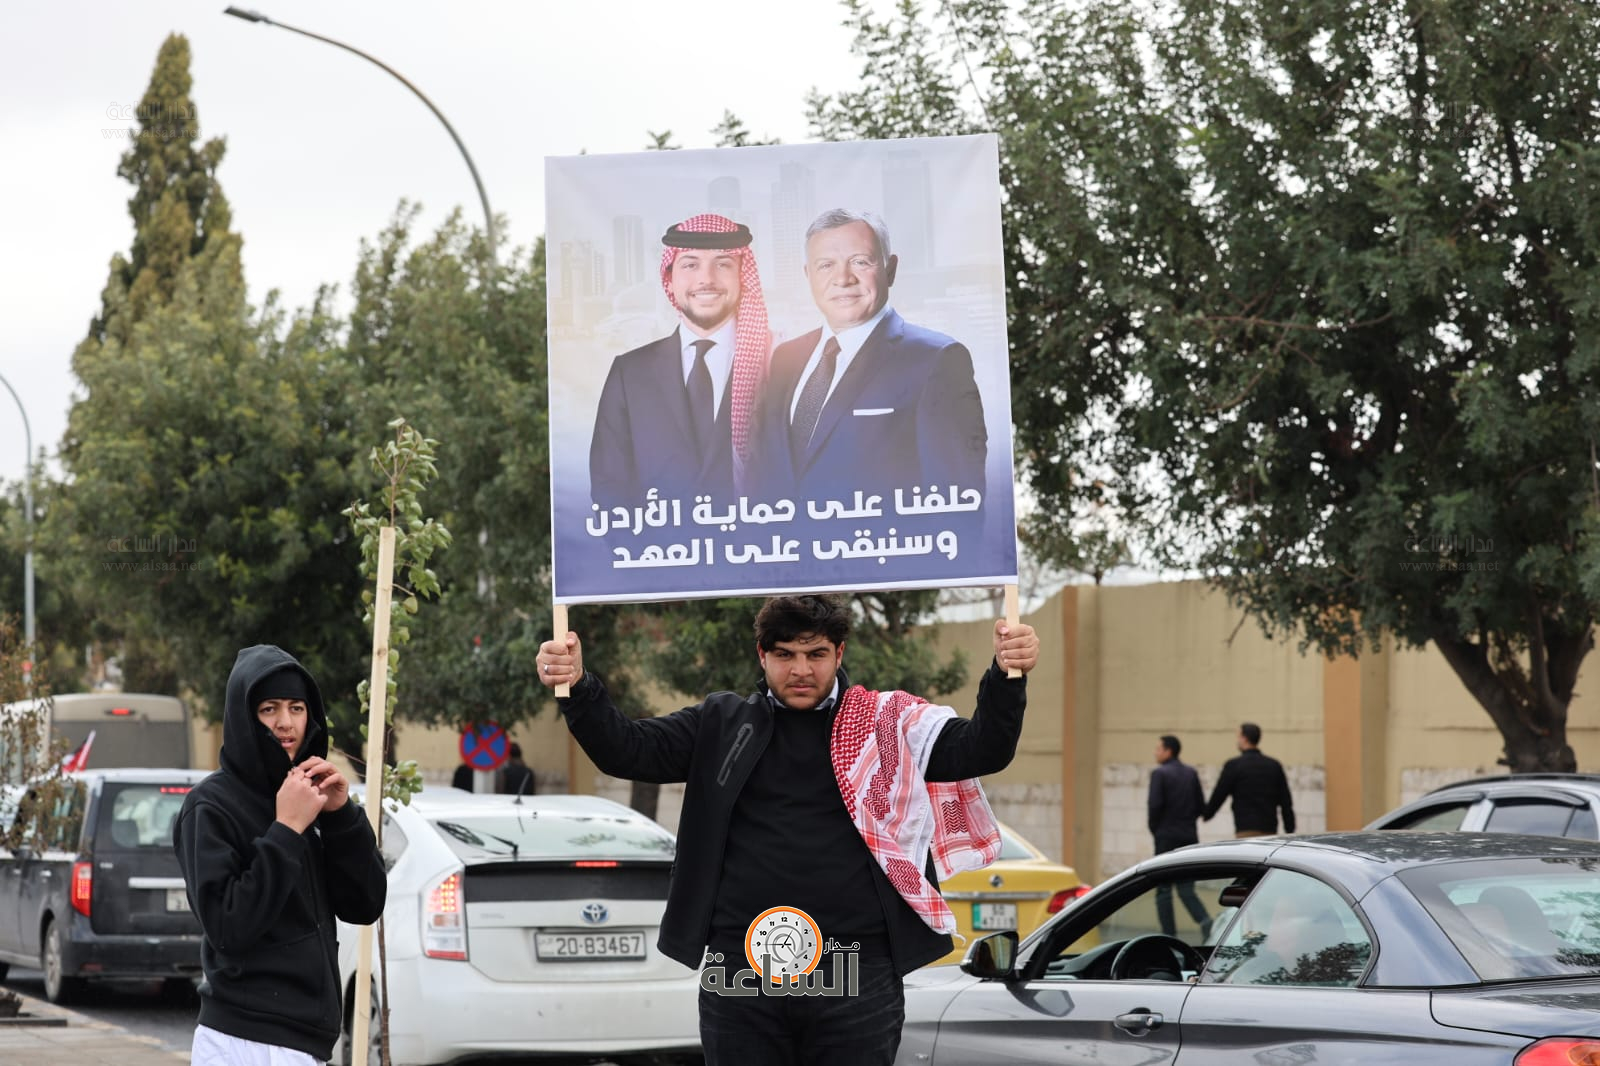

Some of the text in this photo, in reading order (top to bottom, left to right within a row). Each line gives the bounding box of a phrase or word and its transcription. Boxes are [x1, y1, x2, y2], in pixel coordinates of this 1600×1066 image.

[586, 485, 981, 538] حلفنا على حماية الأردن
[613, 528, 958, 569] وسنبقى على العهد
[556, 936, 641, 955] 20-83467
